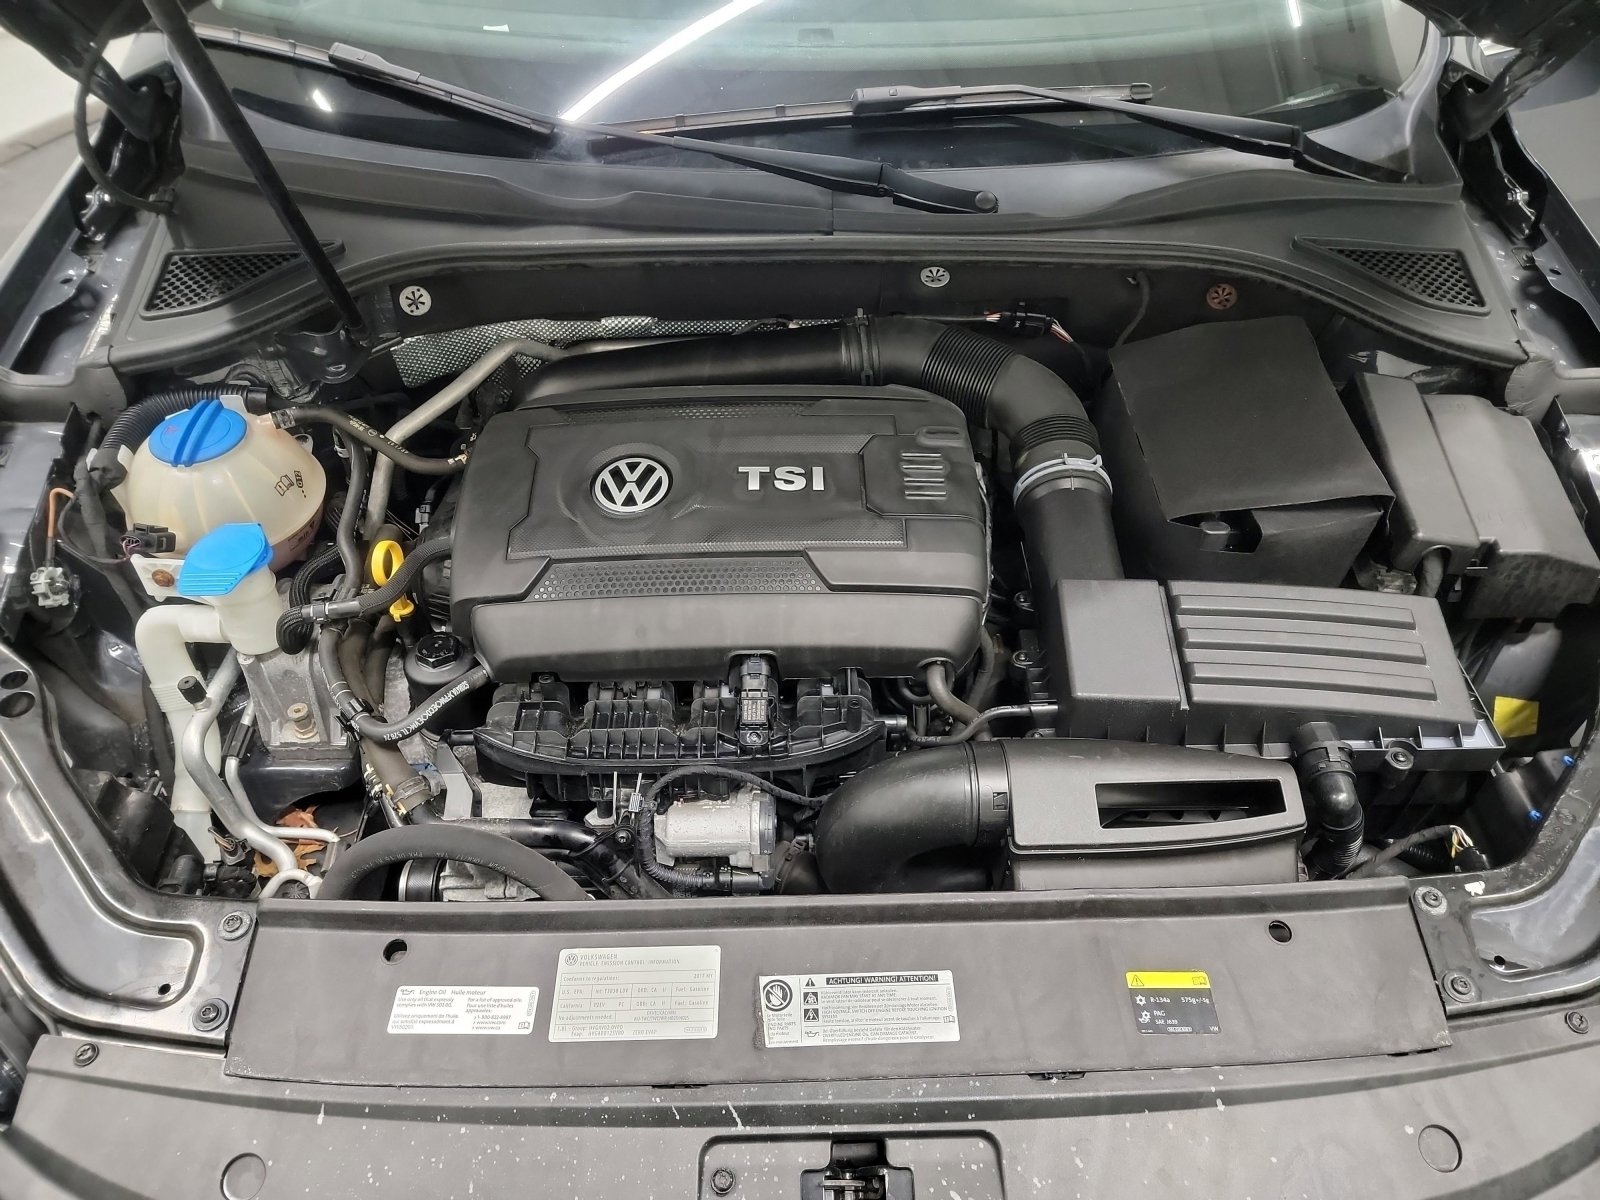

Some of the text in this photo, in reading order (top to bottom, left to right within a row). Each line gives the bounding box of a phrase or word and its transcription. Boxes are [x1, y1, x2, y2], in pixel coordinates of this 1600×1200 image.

[738, 466, 825, 491] TSI
[580, 953, 618, 961] VOLKSWAGEN
[829, 974, 936, 985] ACHTUNG! WARNING! ATTENTION!
[419, 989, 437, 997] Engine
